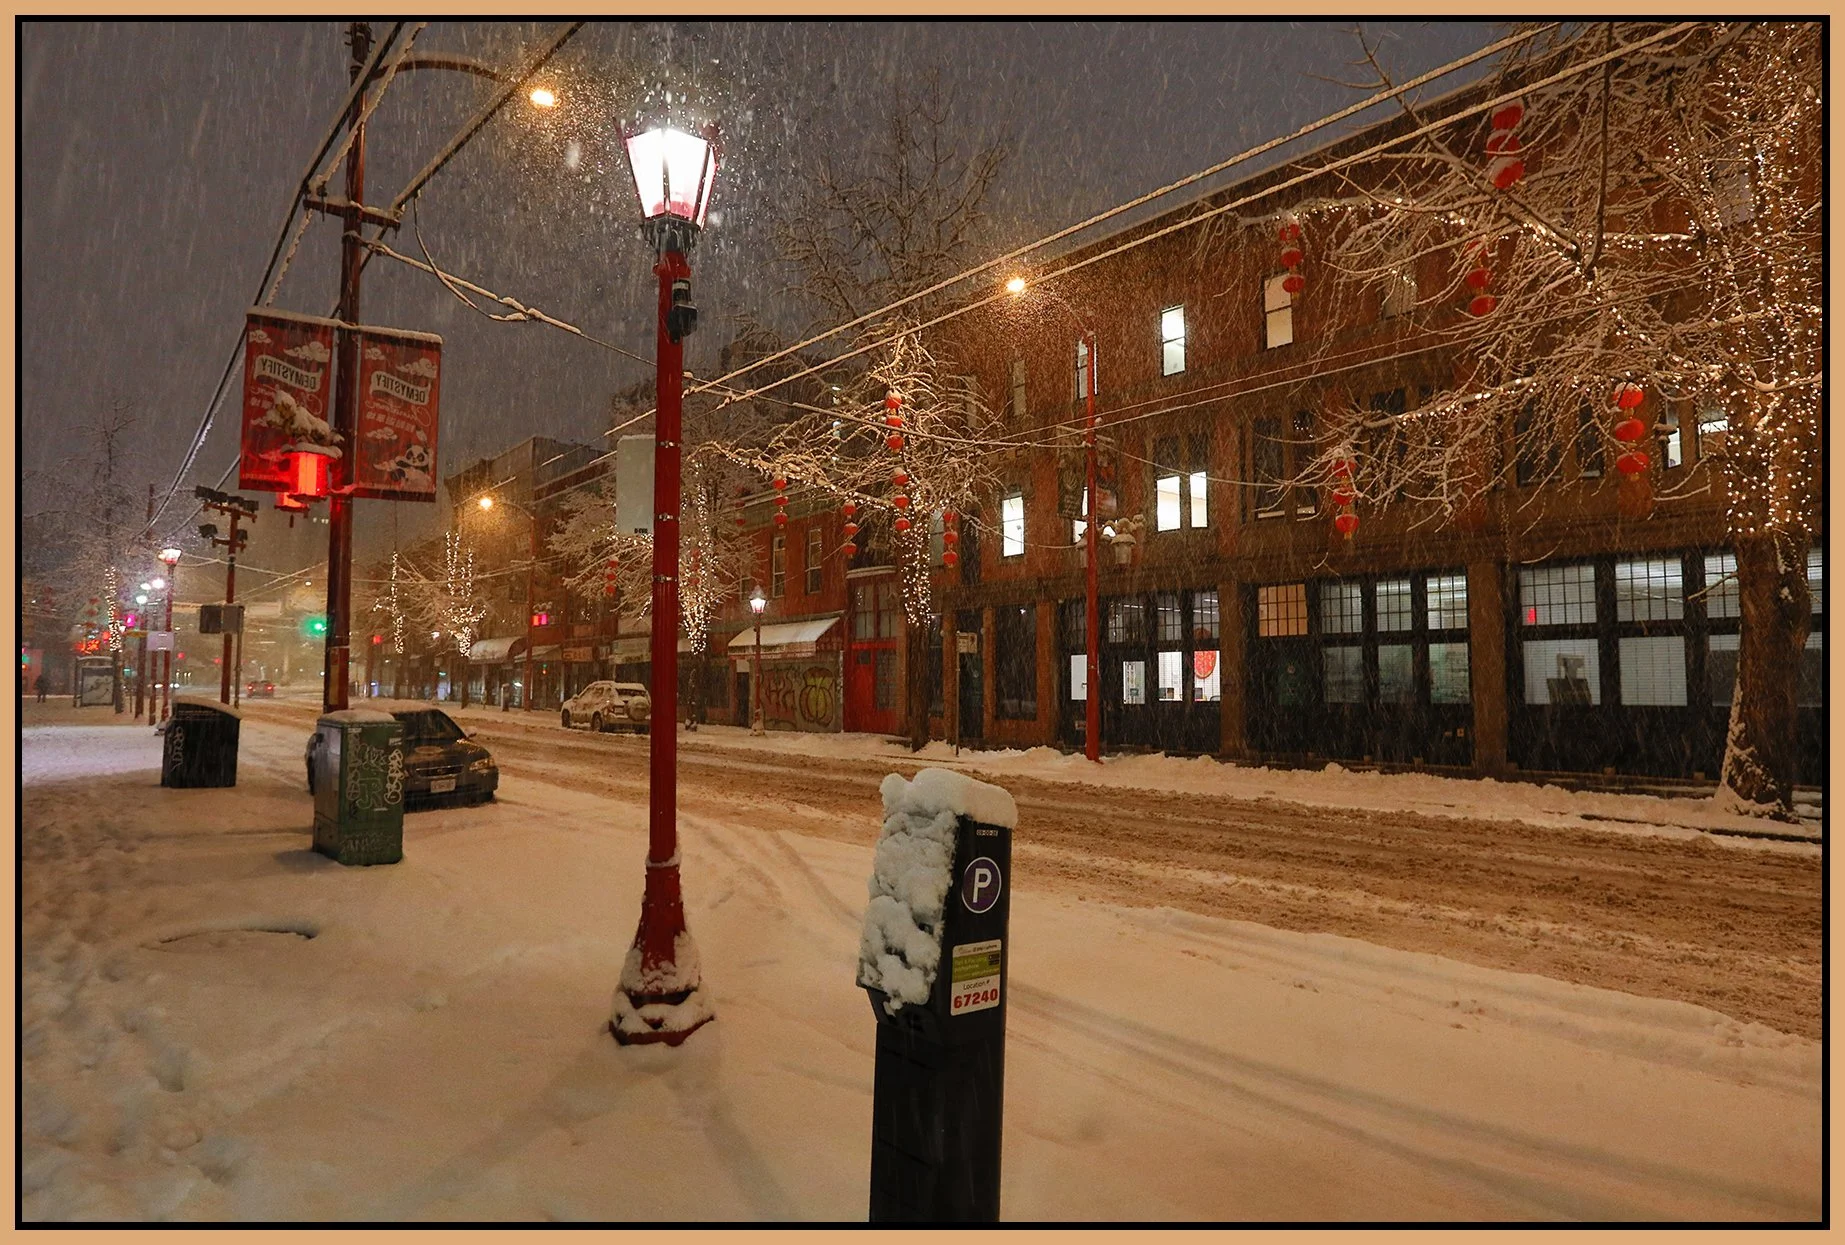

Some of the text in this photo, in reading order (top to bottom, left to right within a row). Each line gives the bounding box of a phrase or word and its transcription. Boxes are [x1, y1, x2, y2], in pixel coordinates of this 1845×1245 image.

[972, 868, 992, 903] P
[963, 980, 986, 990] Location
[953, 988, 998, 1009] 67240
